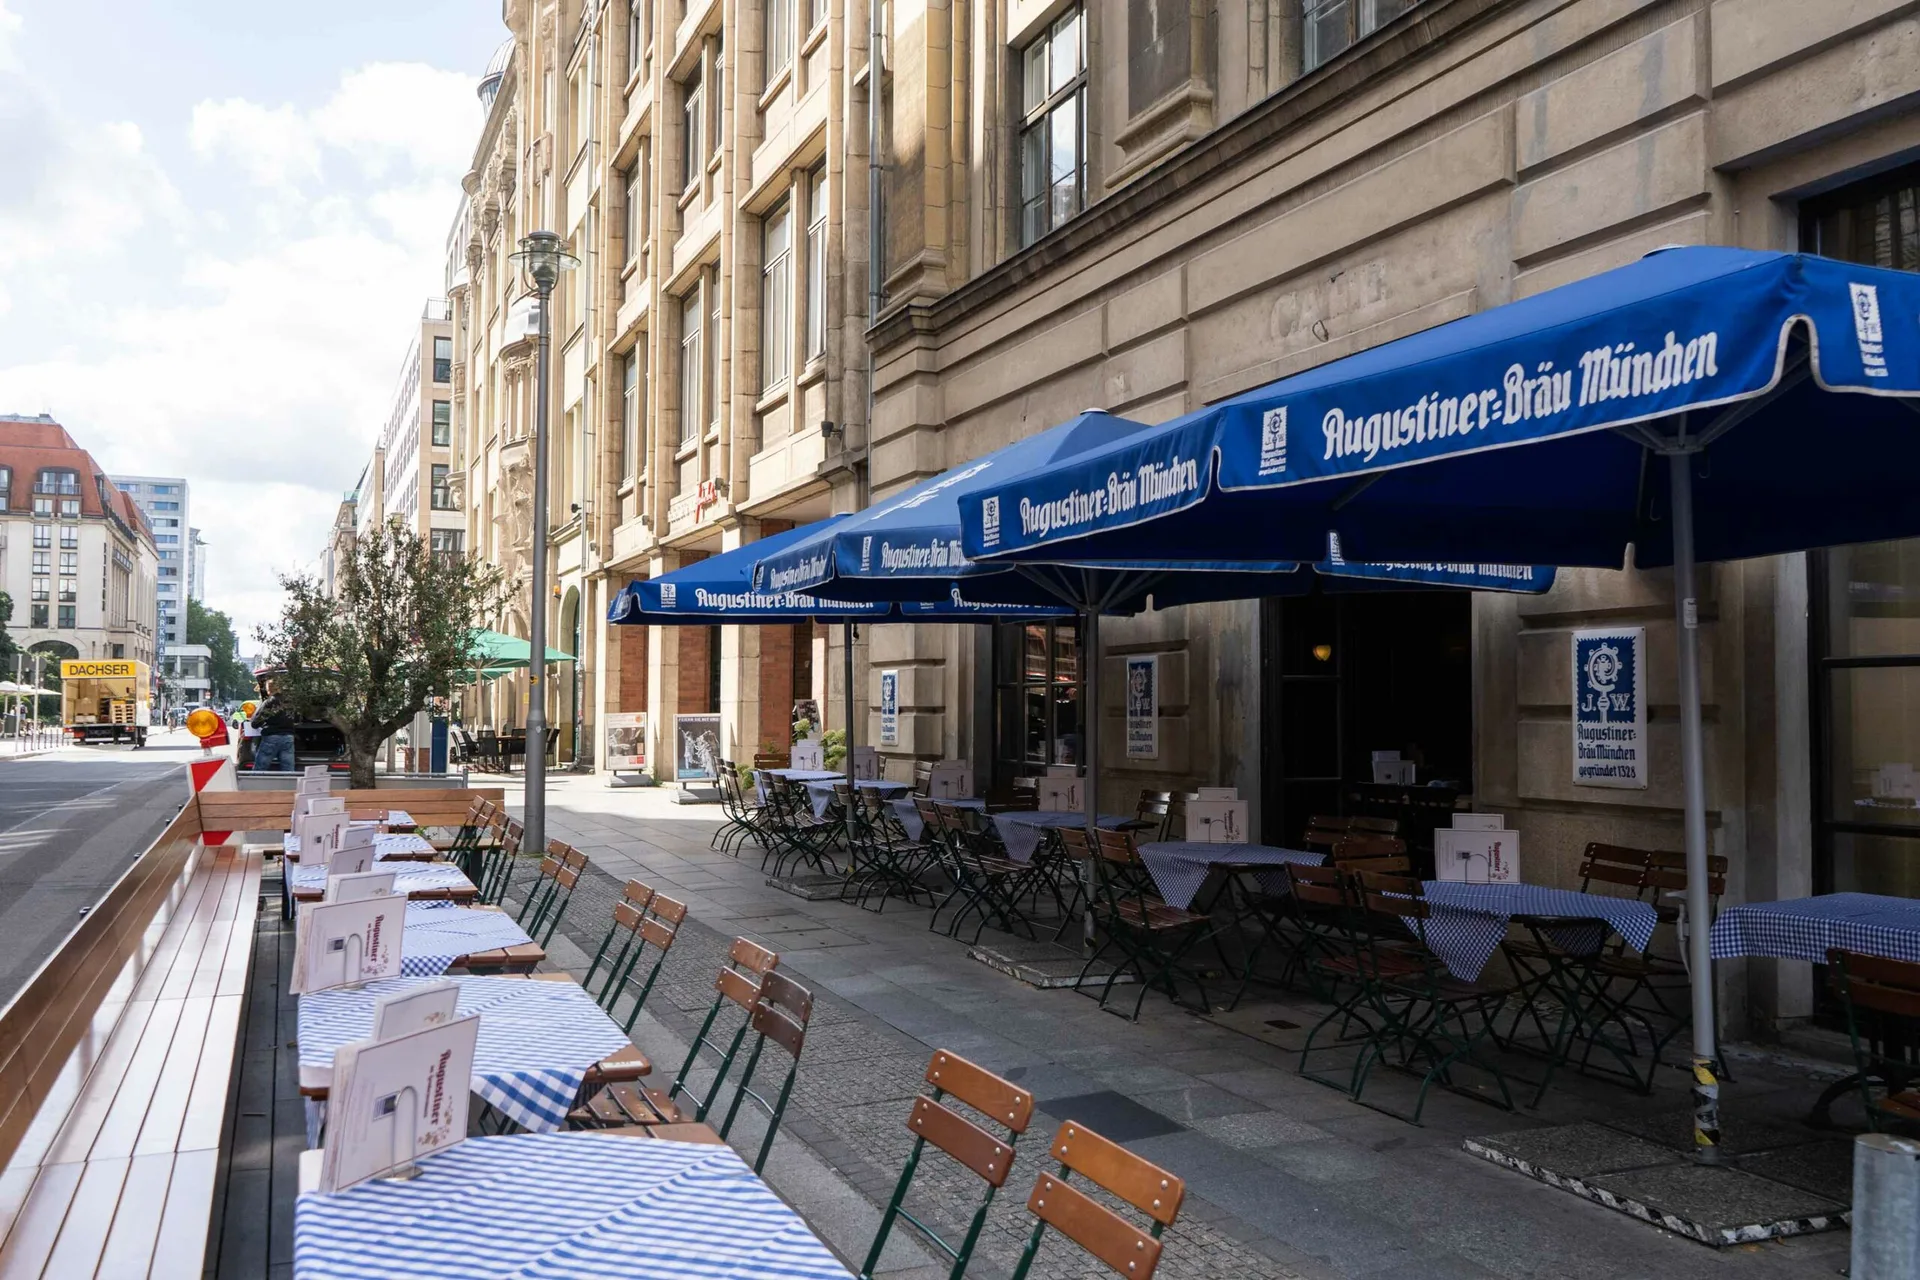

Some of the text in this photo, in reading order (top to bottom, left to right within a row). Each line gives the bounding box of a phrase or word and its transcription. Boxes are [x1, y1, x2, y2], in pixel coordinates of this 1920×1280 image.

[1579, 331, 1718, 406] München
[1138, 455, 1198, 506] München
[69, 664, 129, 676] DACHSER
[1578, 742, 1636, 760] Bräu München
[1579, 764, 1637, 778] gegründet 1328
[370, 914, 386, 963] Augustiner
[431, 1048, 453, 1126] Augustiner
